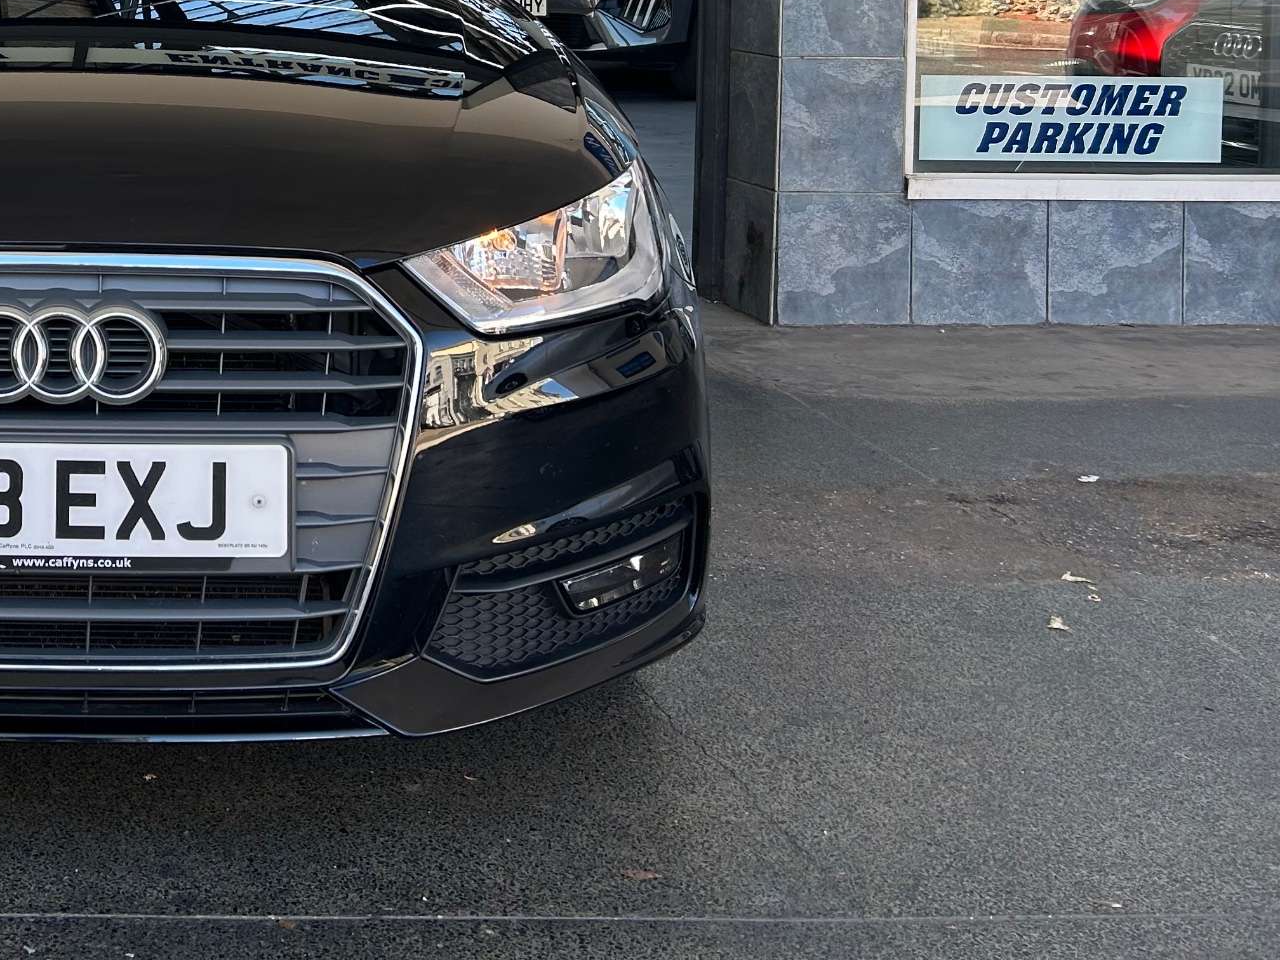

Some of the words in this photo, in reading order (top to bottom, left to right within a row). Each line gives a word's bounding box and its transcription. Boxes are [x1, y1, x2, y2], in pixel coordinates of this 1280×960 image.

[955, 82, 1188, 117] CUSTOMER
[976, 121, 1165, 155] PARKING
[56, 459, 227, 541] EXJ
[12, 556, 131, 569] www.caffyns.co.uk
